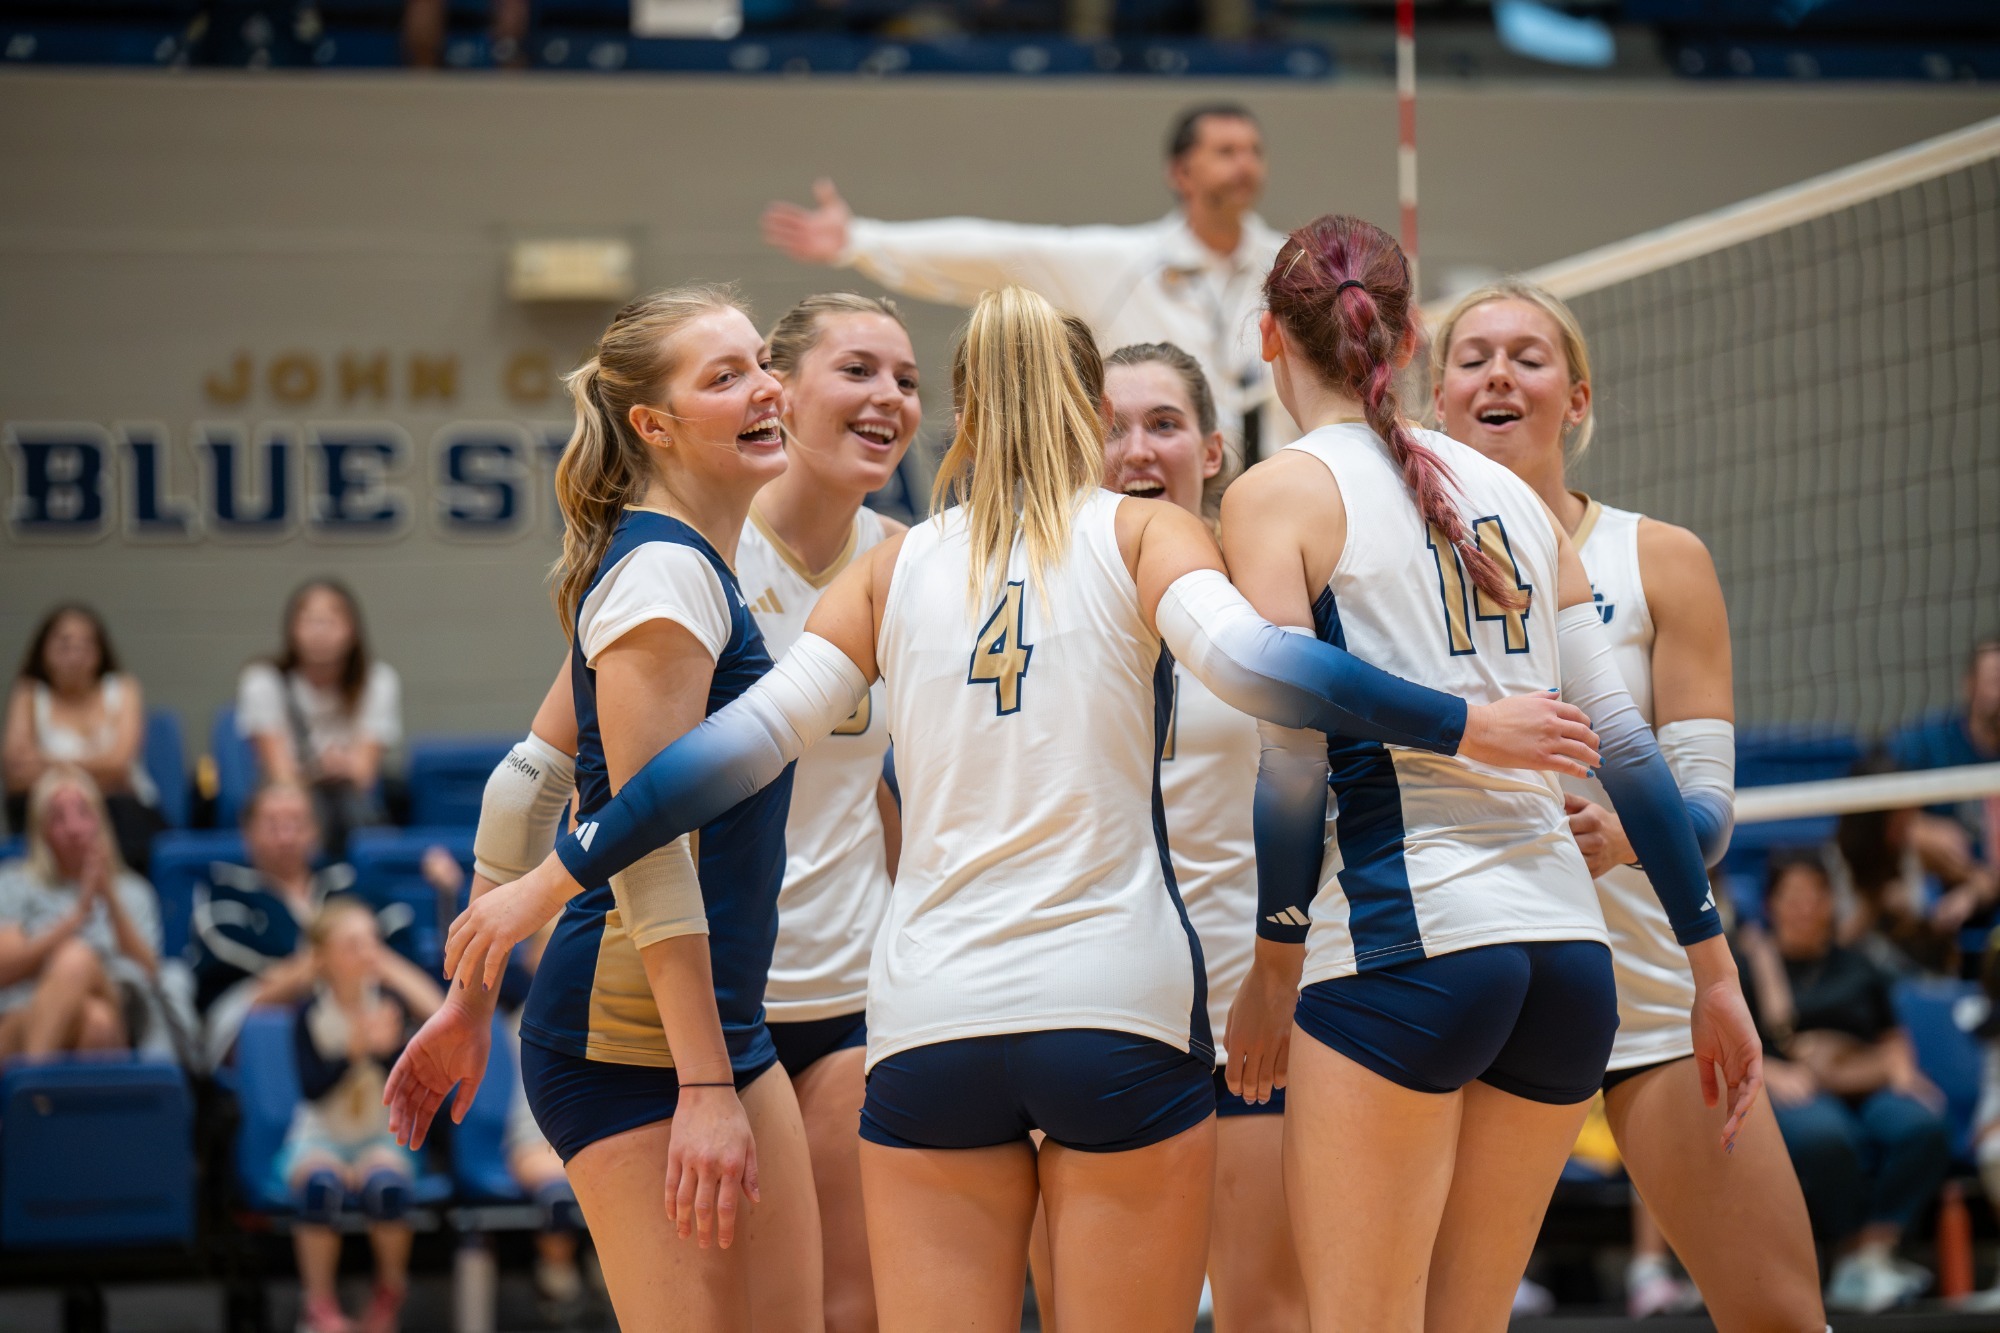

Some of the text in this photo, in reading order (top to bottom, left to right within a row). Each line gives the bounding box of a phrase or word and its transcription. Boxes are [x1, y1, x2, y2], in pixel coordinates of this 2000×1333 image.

[205, 349, 552, 405] JOHN C
[9, 430, 407, 538] BLUE
[1427, 514, 1533, 656] 14
[967, 579, 1034, 717] 4
